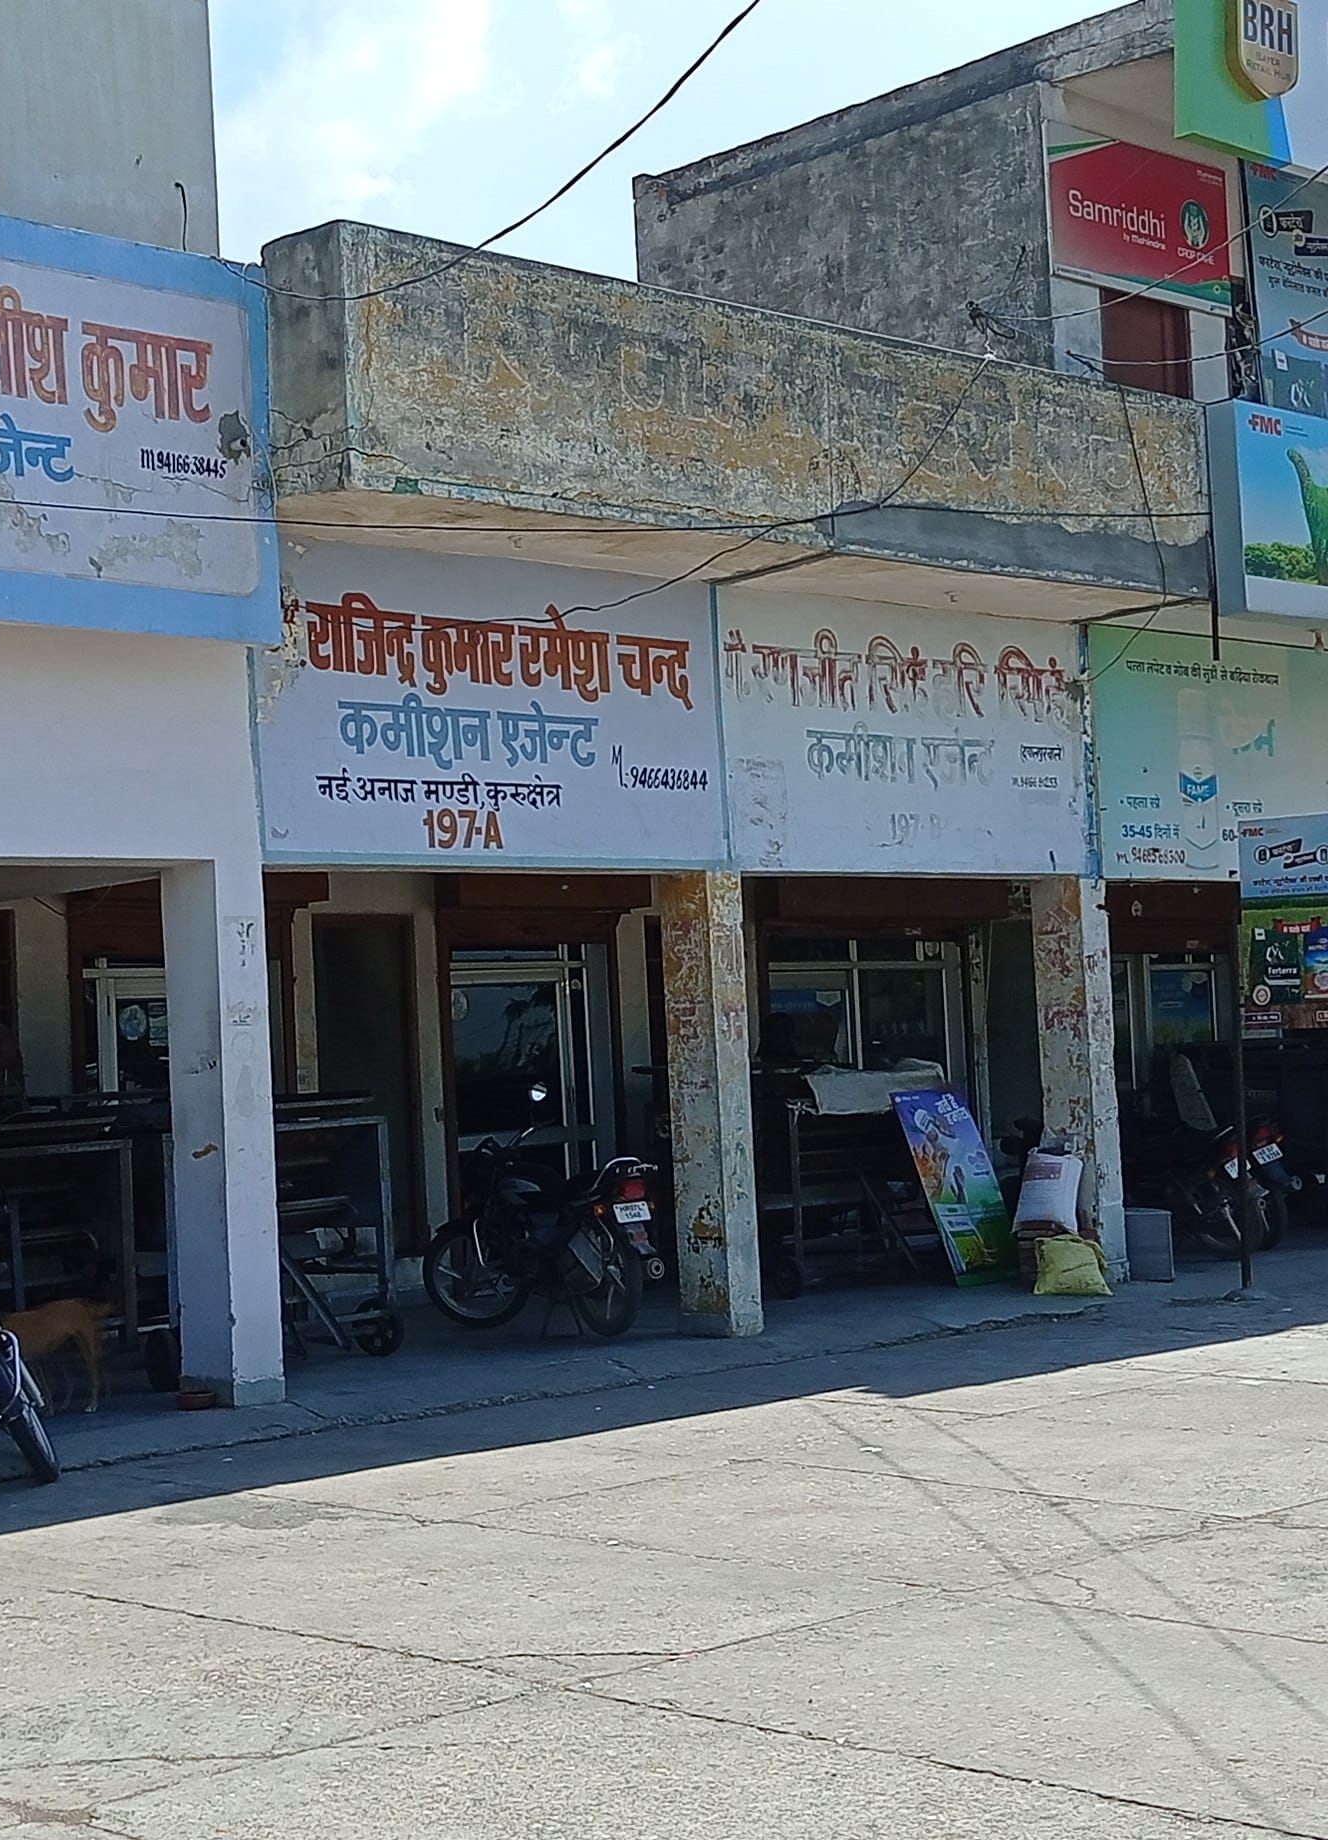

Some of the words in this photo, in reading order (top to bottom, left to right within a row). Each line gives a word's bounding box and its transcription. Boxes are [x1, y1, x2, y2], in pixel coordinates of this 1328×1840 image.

[1243, 0, 1293, 55] BRH
[1067, 189, 1167, 240] Samriddhi
[79, 320, 214, 434] कुमार
[1248, 413, 1283, 437] FMC
[420, 613, 519, 696] कुमार
[518, 604, 612, 703] रमेश
[337, 691, 492, 771] कमीशन
[497, 700, 600, 769] एजेन्ट
[315, 767, 352, 802] नई
[352, 774, 419, 804] अनाज
[422, 808, 504, 851] 197-A
[1121, 824, 1152, 838] 35-45
